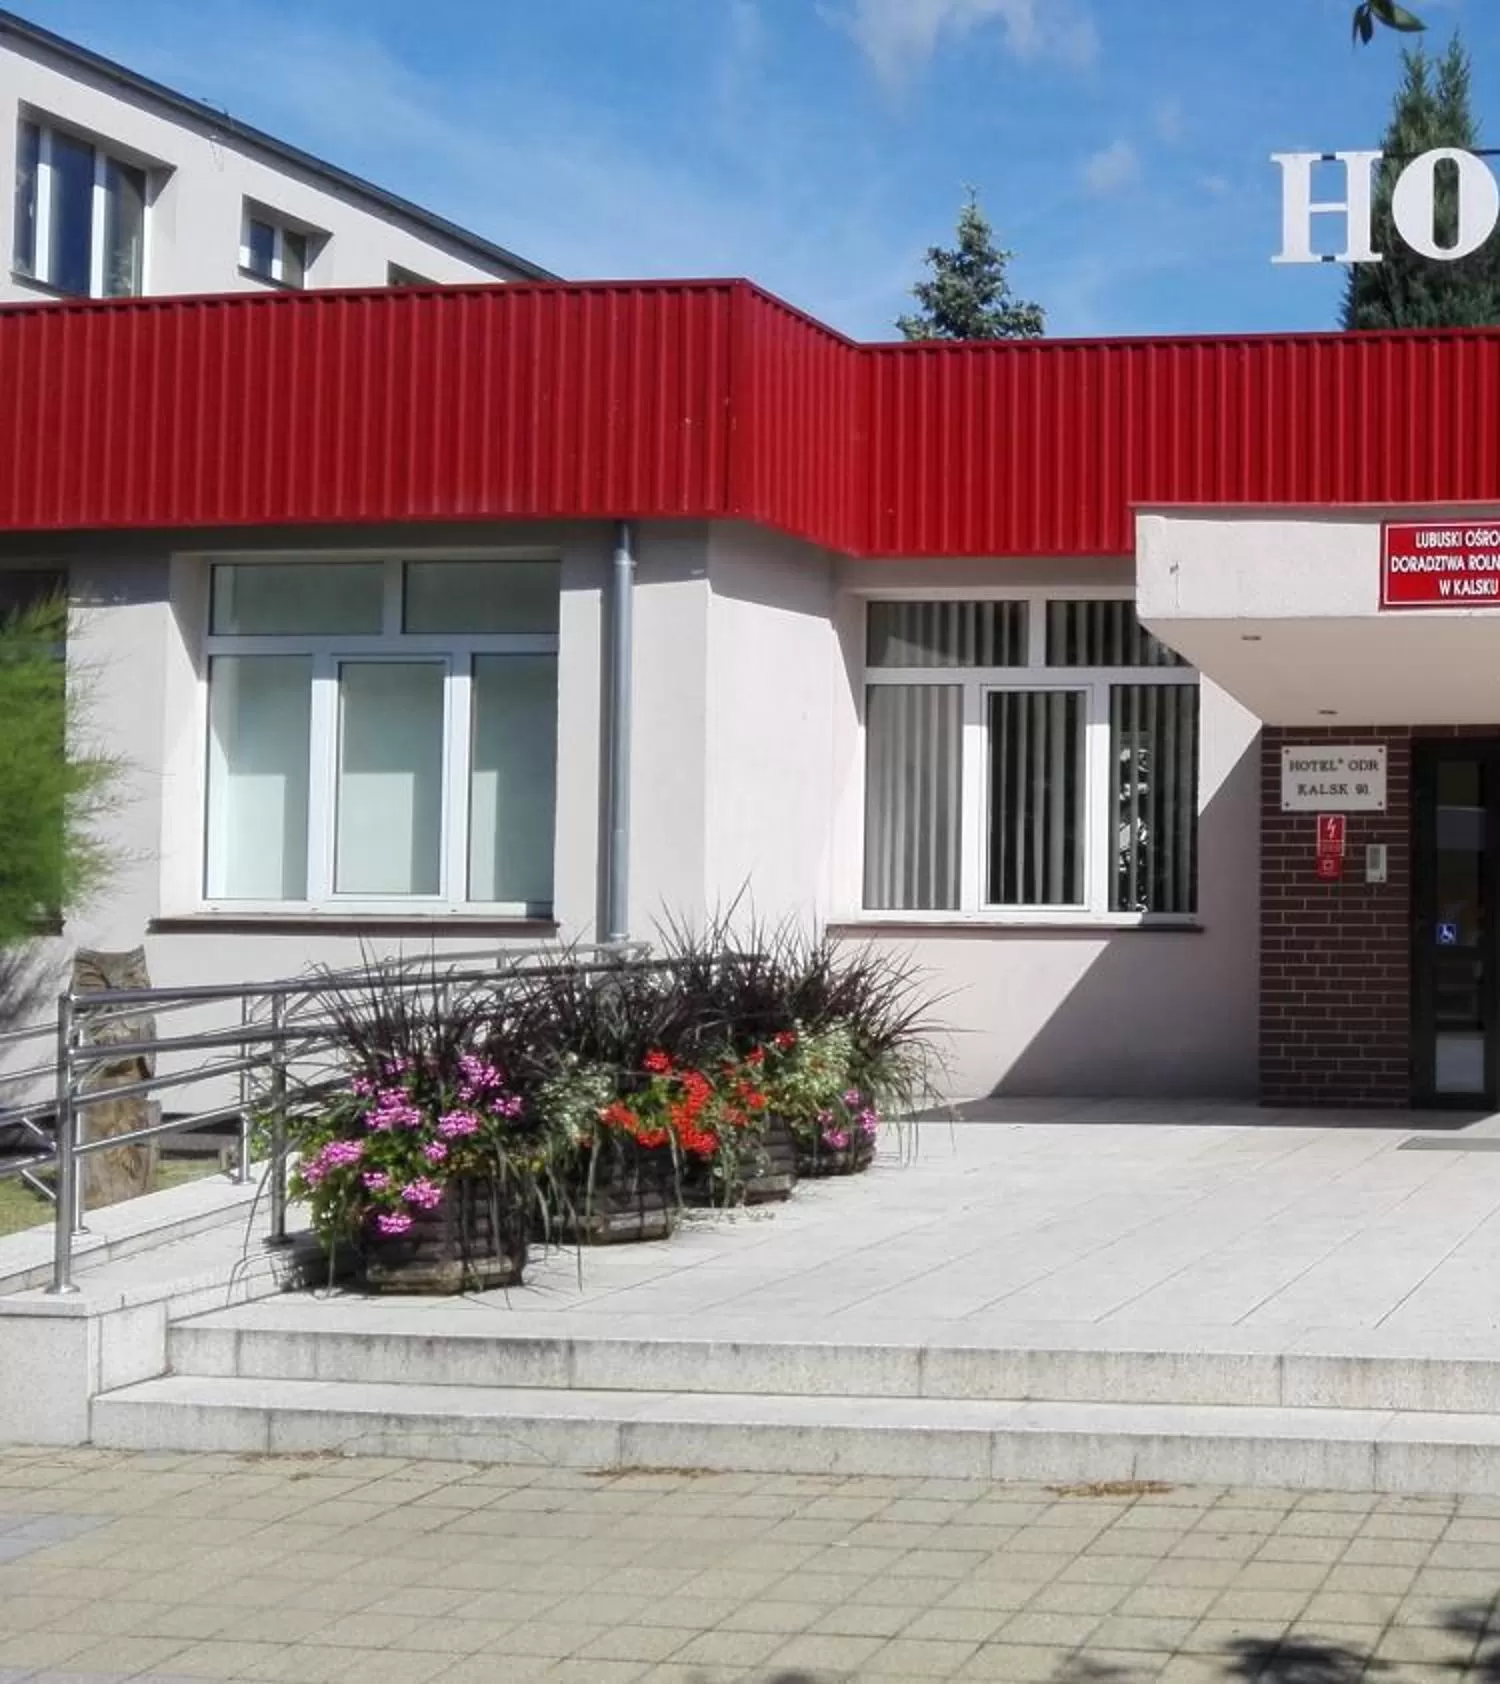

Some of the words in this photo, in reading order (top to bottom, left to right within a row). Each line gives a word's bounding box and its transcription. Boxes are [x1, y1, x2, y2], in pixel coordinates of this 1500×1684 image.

[1415, 531, 1463, 549] LUBUSKI
[1391, 555, 1465, 573] DORADZTWA
[1438, 579, 1451, 596] W
[1453, 578, 1499, 595] KALSKU
[1347, 759, 1380, 772] ODR
[1297, 783, 1349, 796] KALSK
